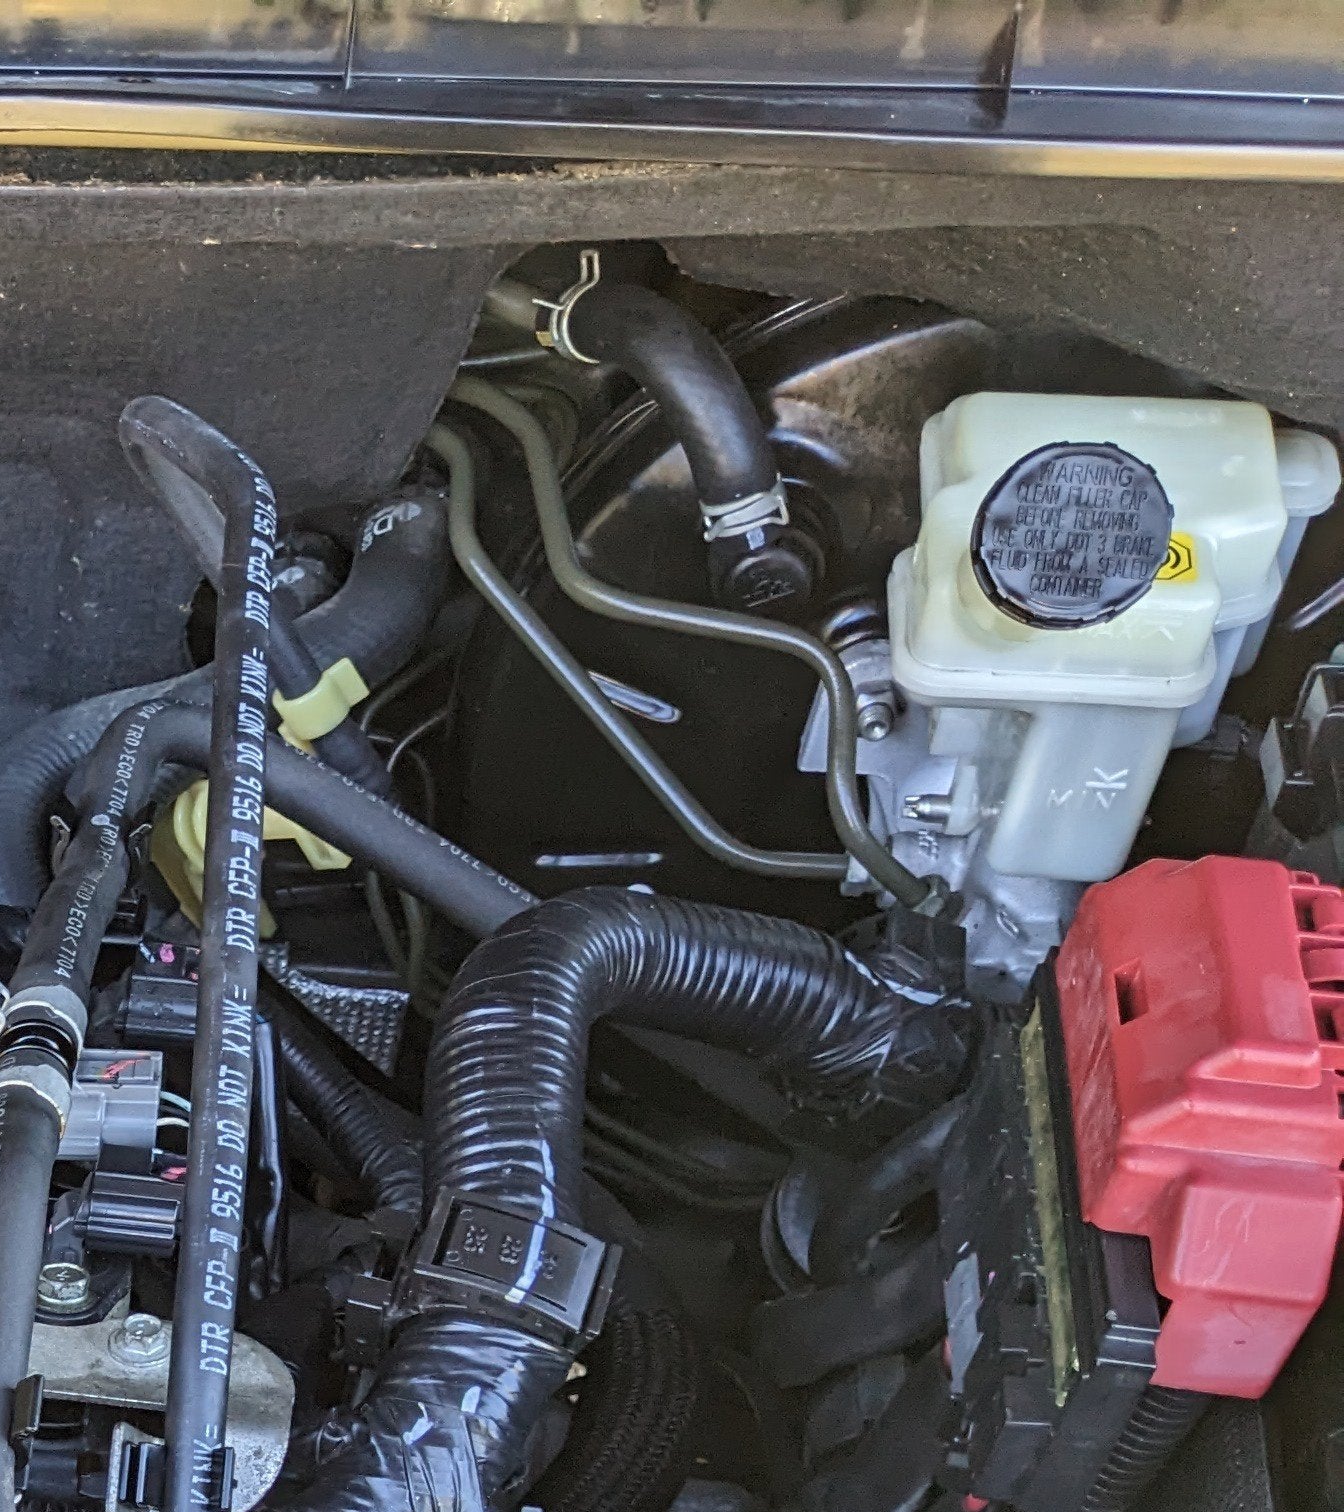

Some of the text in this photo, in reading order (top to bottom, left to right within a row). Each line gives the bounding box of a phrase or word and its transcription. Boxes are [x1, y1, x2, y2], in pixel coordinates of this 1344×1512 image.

[1039, 461, 1135, 488] WARNING
[1016, 482, 1148, 510] CLEAN FILLER CAP
[1015, 505, 1140, 531] BEFORE REMOVING
[991, 526, 1156, 557] USE ONLY DOT 3 BRAKE
[990, 550, 1150, 580] FLUID FROM A SEALED
[1029, 574, 1103, 598] CONTAINER
[237, 701, 266, 743] NOT
[237, 744, 265, 774] DO
[231, 774, 263, 825] 9516
[225, 905, 257, 953] DTR
[218, 1063, 250, 1113] NOT
[217, 1116, 247, 1155] DO
[211, 1162, 244, 1221] 9516
[199, 1320, 231, 1376] DTR
